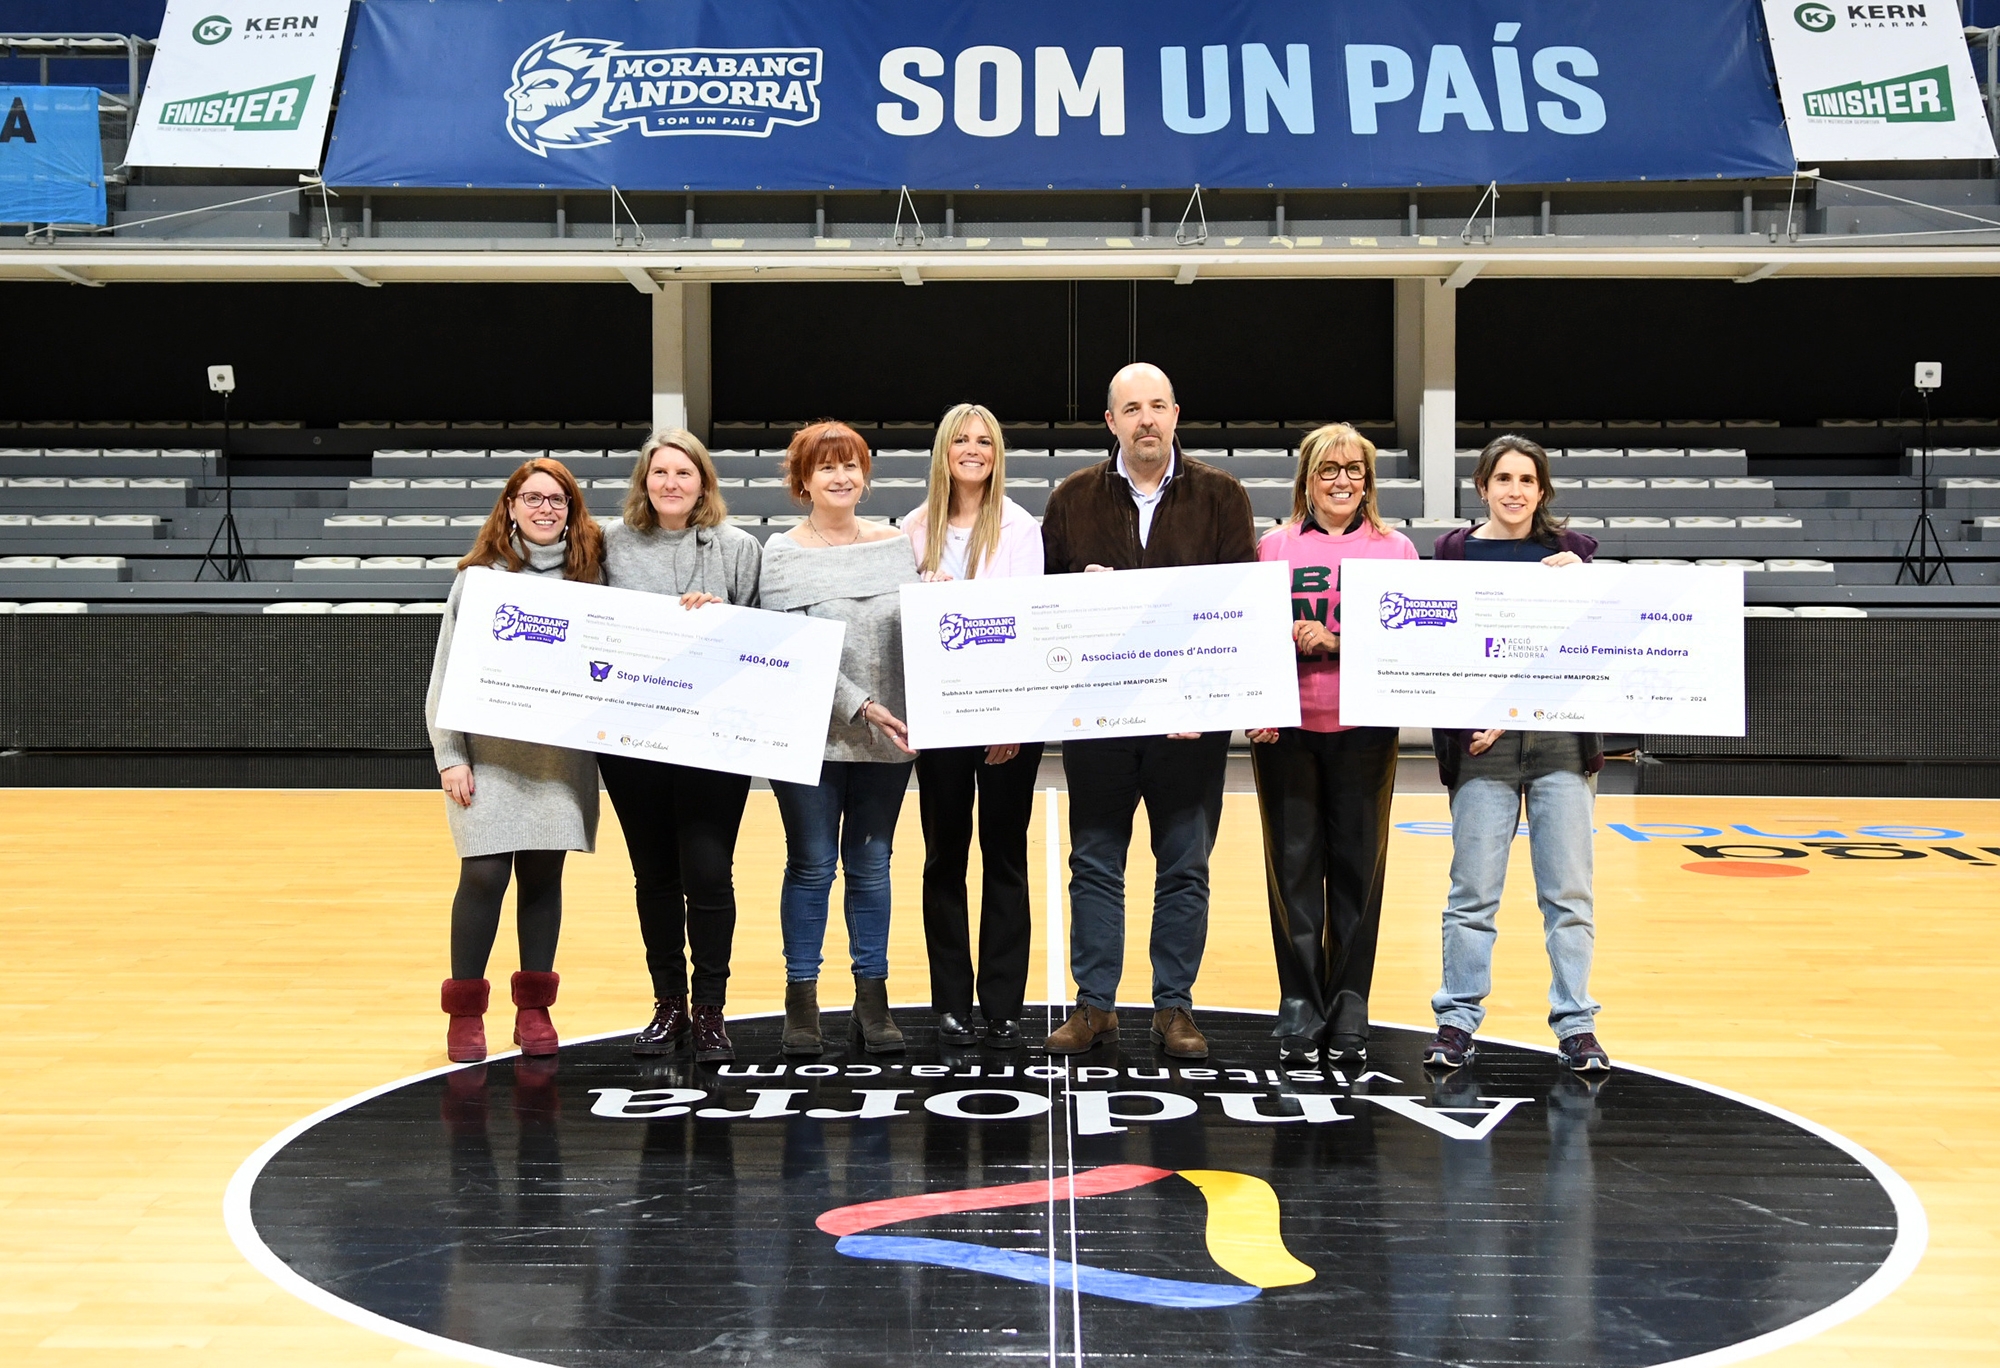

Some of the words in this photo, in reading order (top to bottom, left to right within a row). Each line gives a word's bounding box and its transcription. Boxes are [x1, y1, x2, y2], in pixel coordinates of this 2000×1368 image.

[1847, 4, 1926, 19] KERN
[245, 16, 319, 31] KERN
[244, 32, 315, 40] PHARMA
[613, 57, 811, 78] MORABANC
[876, 46, 1126, 136] SOM
[1160, 43, 1315, 134] UN
[1344, 22, 1607, 135] PAÍS
[609, 81, 808, 113] ANDORRA
[1807, 78, 1941, 116] FINISHER
[164, 88, 299, 123] FINISHER
[0, 97, 36, 143] A
[658, 117, 690, 126] SOM
[696, 117, 716, 125] UN
[722, 116, 756, 127] PAÍS
[1291, 566, 1340, 593] B
[1405, 600, 1456, 608] MORABANC
[519, 614, 568, 628] MORABANC
[1193, 610, 1243, 621] #404,00#
[1405, 608, 1456, 620] ANDORRA
[1499, 610, 1516, 618] Euro
[1640, 612, 1693, 622] #404,00#
[964, 617, 1014, 627] MORABANC
[1056, 622, 1072, 630] Euro
[517, 622, 566, 640] ANDORRA
[965, 625, 1014, 639] ANDORRA
[606, 635, 622, 644] Euro
[1508, 637, 1531, 645] ACCIÓ
[1081, 650, 1136, 662] Associació
[1139, 650, 1151, 658] de
[1154, 649, 1184, 658] dones
[1187, 646, 1237, 656] d'Andorra
[1508, 645, 1549, 653] FEMINISTA
[1508, 651, 1545, 659] ANDORRA
[1559, 645, 1589, 654] Acció
[1591, 645, 1643, 655] Feminista
[1646, 647, 1688, 656] Andorra
[739, 654, 790, 668] #404,00#
[617, 670, 640, 683] Stop
[643, 674, 693, 690] Violències
[1093, 680, 1121, 688] especial
[1123, 677, 1167, 685] #MAIPOR25N
[480, 678, 510, 687] Subhasta
[512, 684, 548, 693] samarretes
[562, 690, 583, 698] primer
[585, 694, 603, 702] equip
[626, 701, 654, 709] especial
[656, 705, 699, 715] #MAIPOR25N
[489, 697, 511, 705] Andorra
[735, 734, 756, 742] Febrer
[718, 1063, 1404, 1085] visitandorra.com
[587, 1088, 1536, 1140] Andorra
